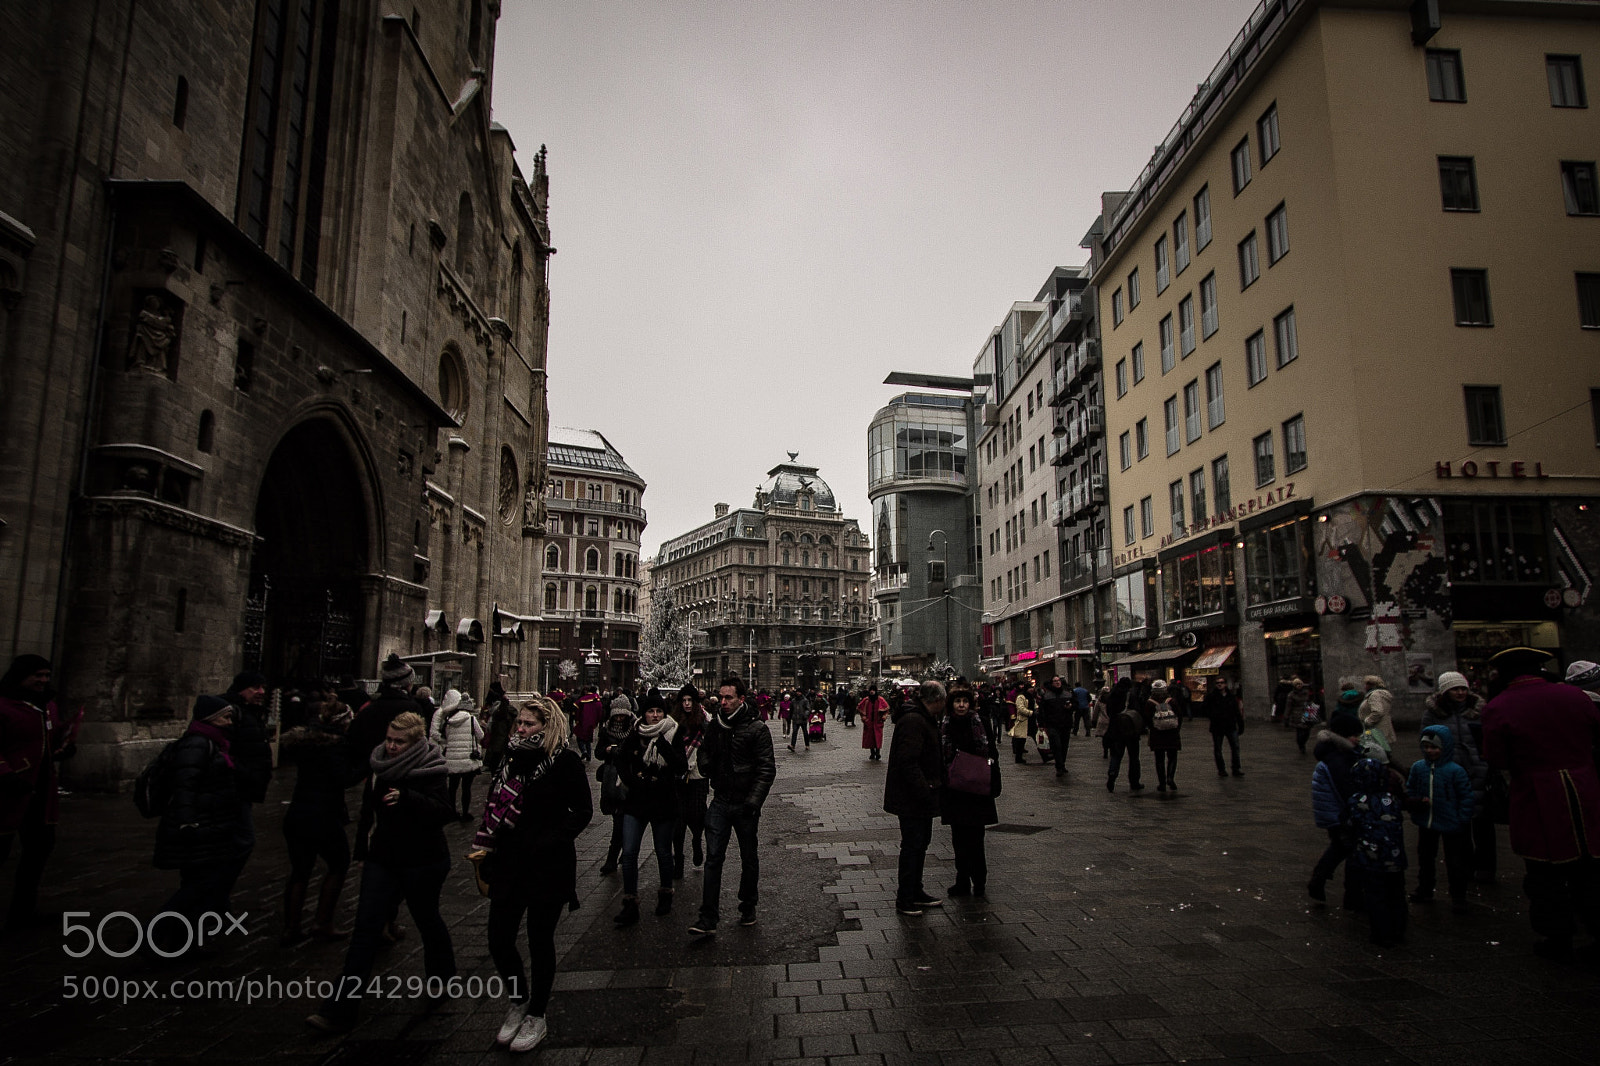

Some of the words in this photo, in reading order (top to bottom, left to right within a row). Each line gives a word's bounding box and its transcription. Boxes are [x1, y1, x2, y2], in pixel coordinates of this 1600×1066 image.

[1436, 460, 1549, 479] HOTEL
[1115, 545, 1145, 566] HOTEL
[1183, 482, 1297, 537] STEPHANSPLATZ
[1263, 607, 1274, 617] BAR
